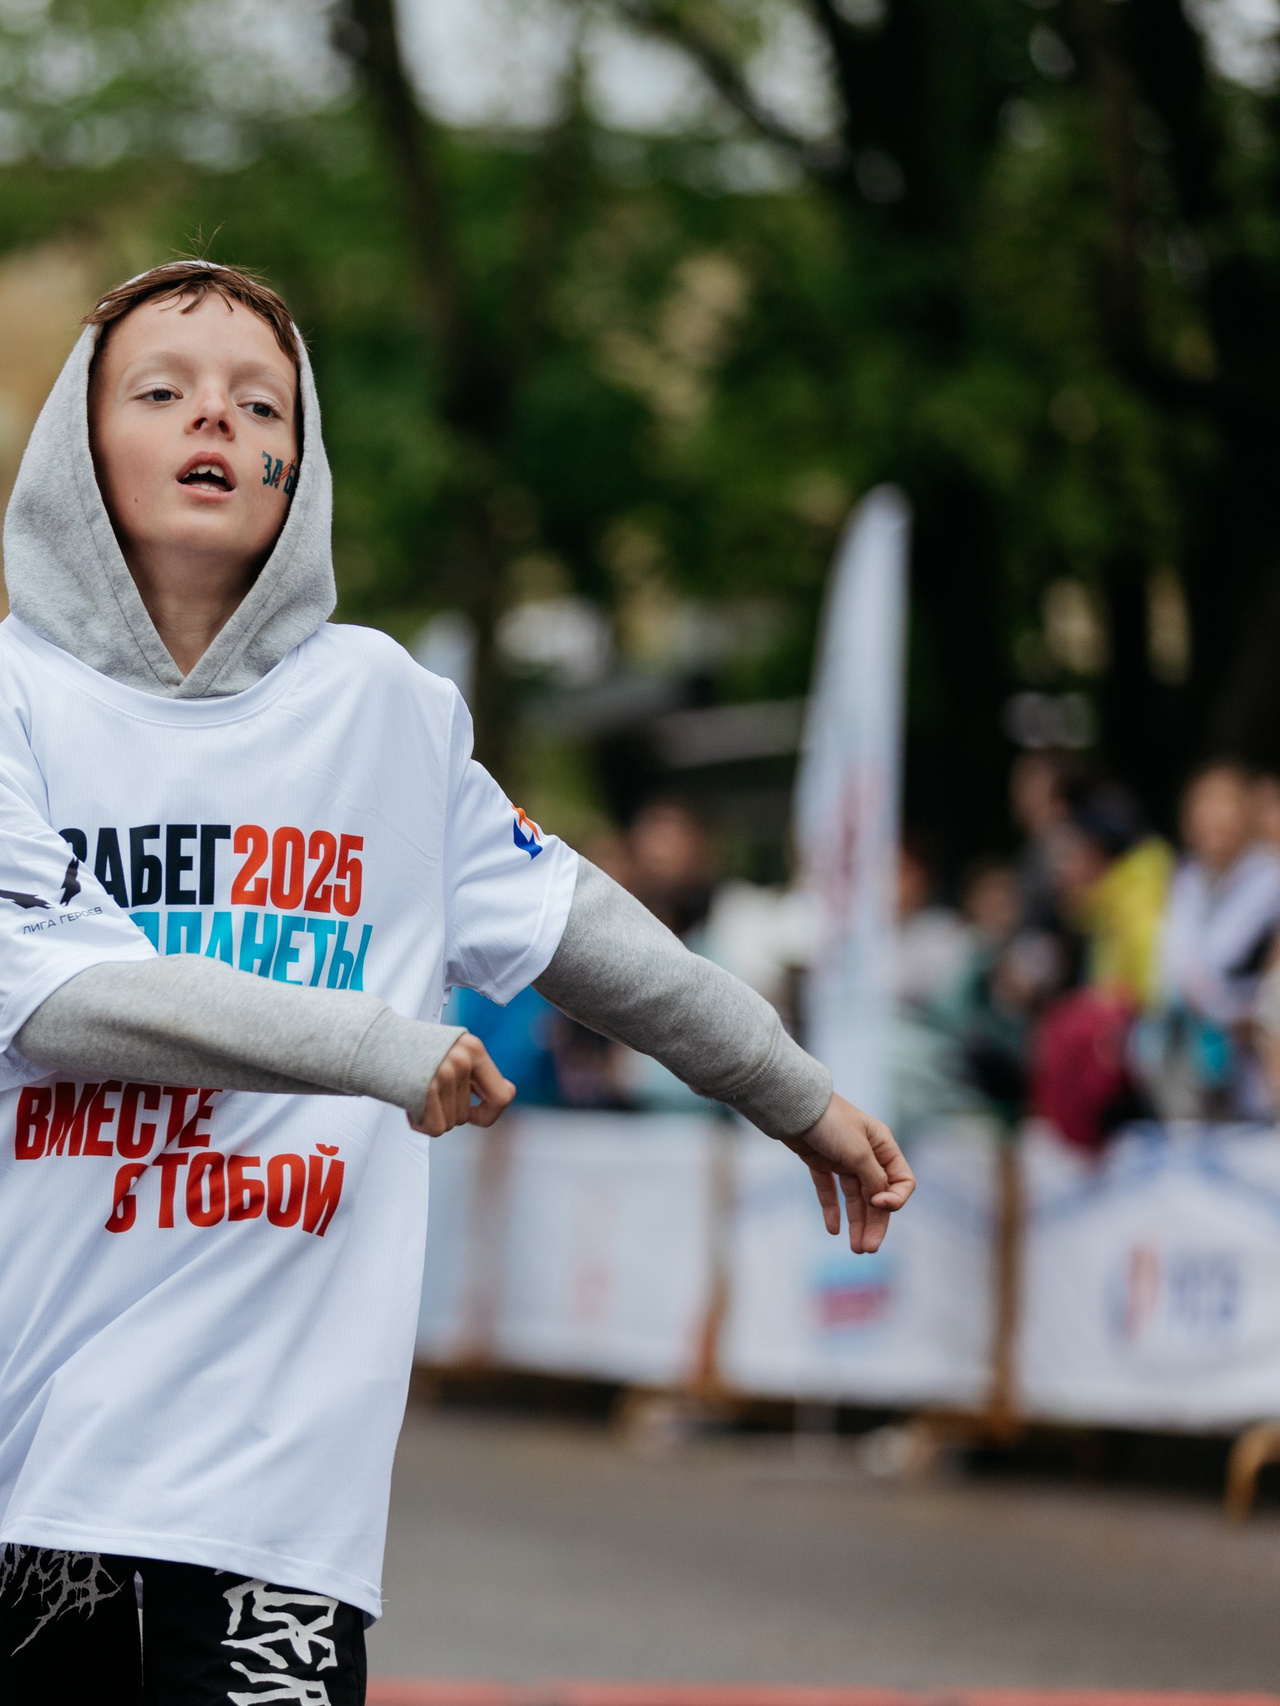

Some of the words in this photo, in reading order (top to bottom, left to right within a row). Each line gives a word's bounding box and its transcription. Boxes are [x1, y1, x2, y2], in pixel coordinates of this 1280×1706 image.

[23, 919, 57, 935] ЛИГА
[60, 906, 103, 924] ГЕРОЕВ
[15, 1079, 223, 1160] ВМЕСТЕ
